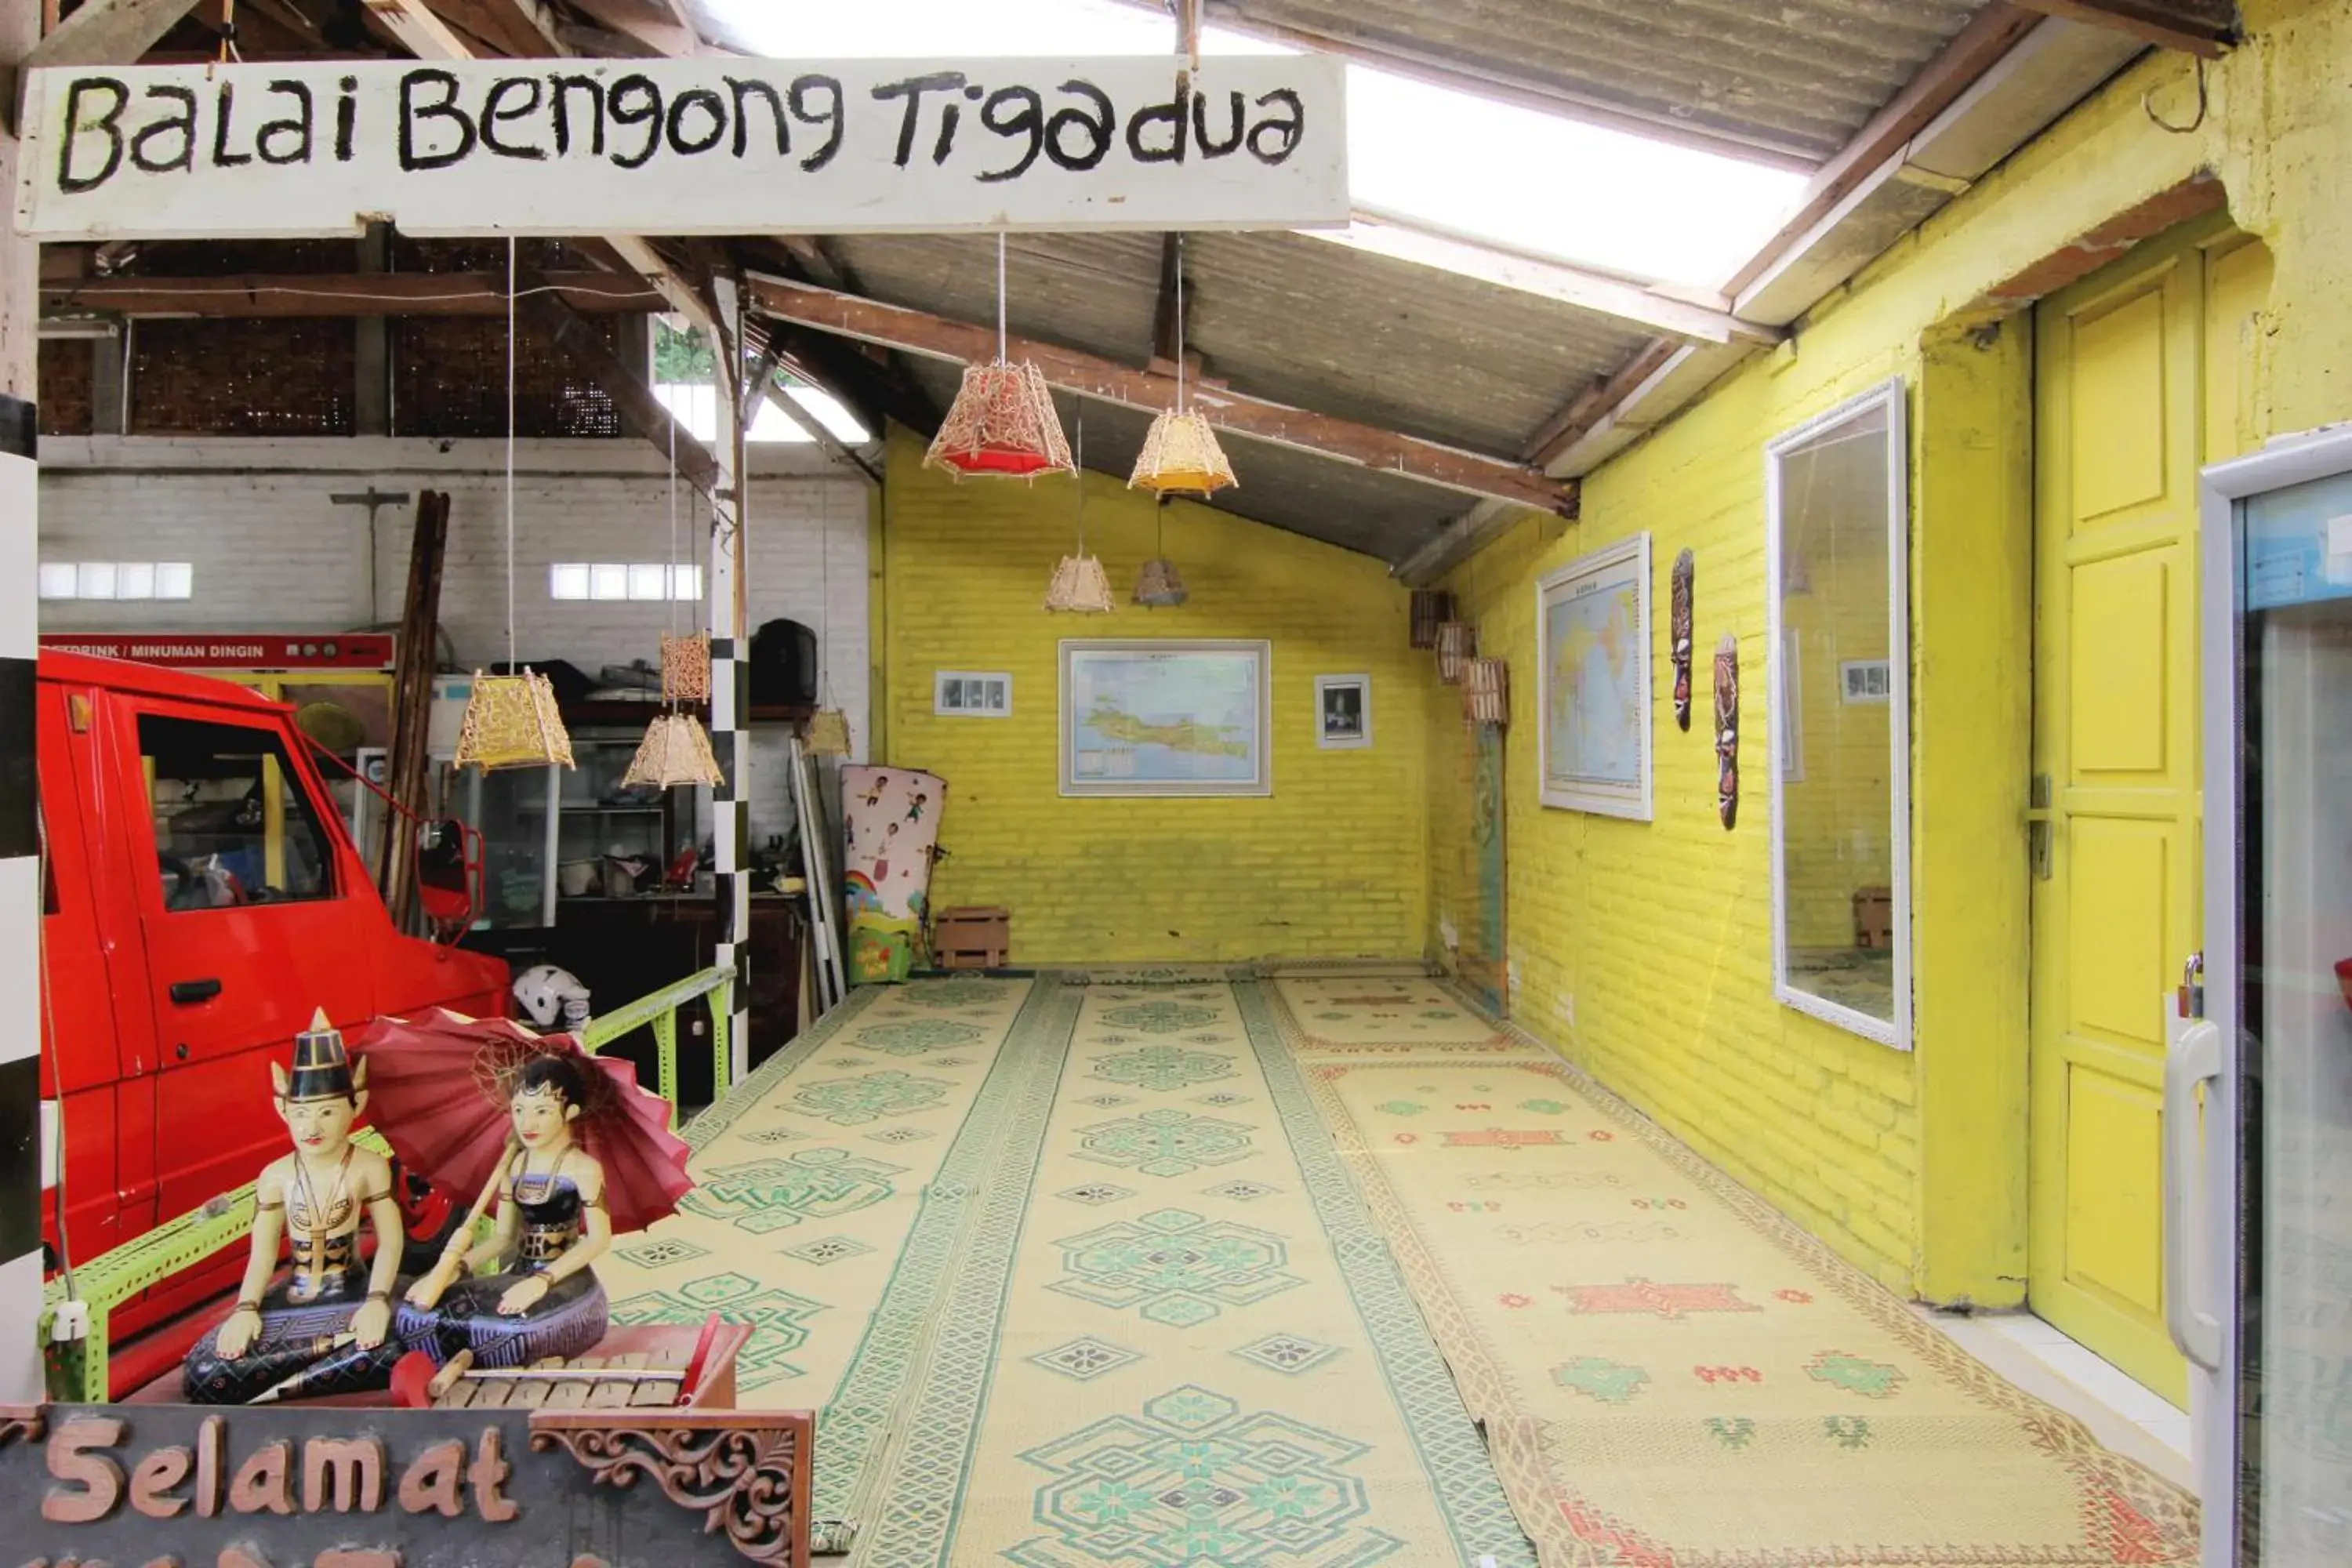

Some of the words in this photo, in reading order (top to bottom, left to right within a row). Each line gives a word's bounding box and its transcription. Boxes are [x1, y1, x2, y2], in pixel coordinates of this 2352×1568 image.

[397, 67, 844, 172] Bengong
[131, 644, 205, 657] MINUMAN
[210, 644, 264, 657] DINGIN
[41, 1414, 521, 1523] Selamat
